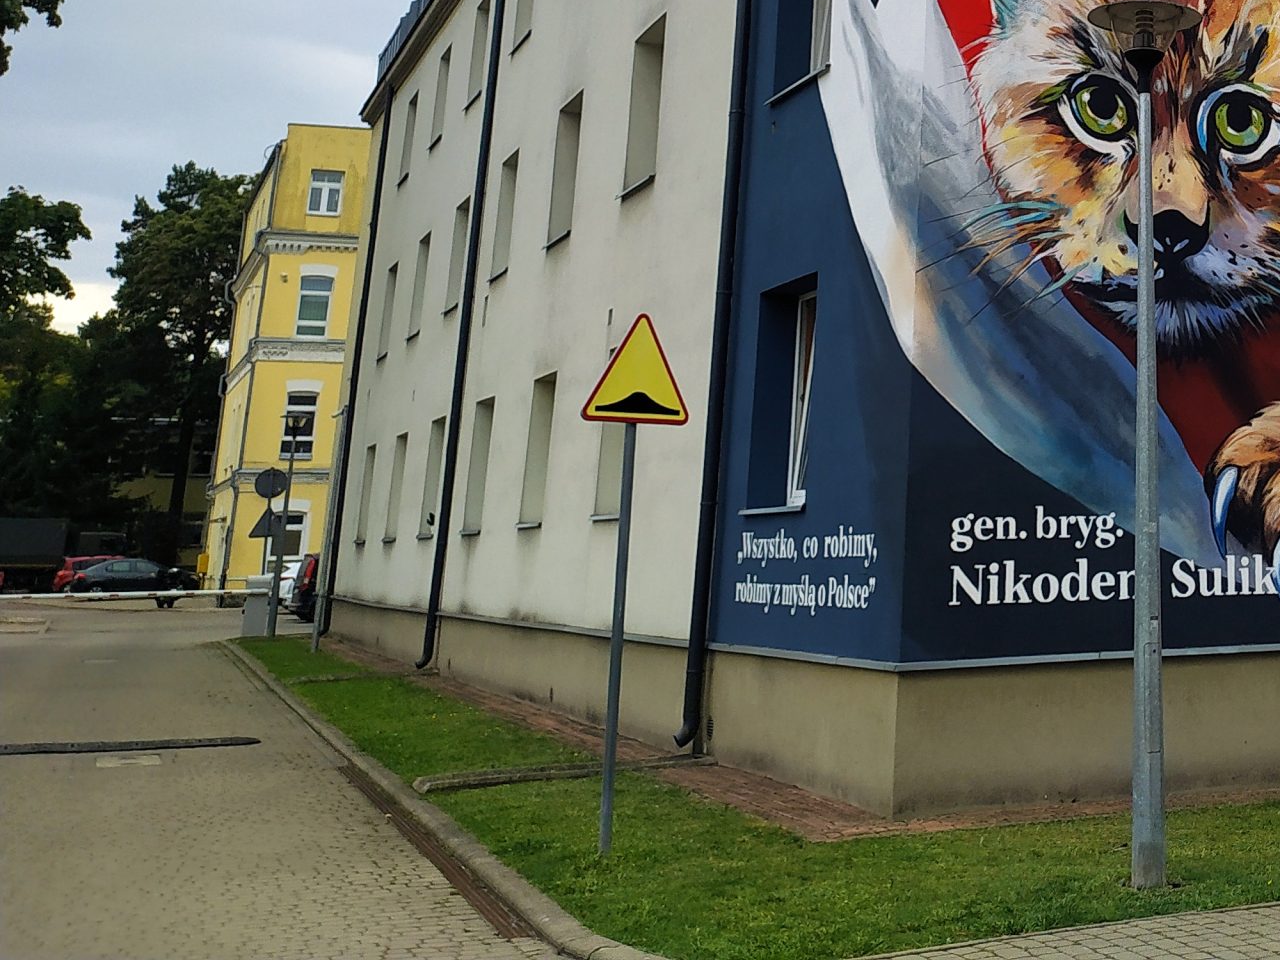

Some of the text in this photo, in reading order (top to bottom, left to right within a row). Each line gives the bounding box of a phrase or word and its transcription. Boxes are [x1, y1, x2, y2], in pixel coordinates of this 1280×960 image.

[802, 536, 818, 558] co
[824, 525, 877, 568] robimy,
[950, 505, 1124, 552] gen. bryg.
[735, 573, 773, 614] robimy
[773, 583, 781, 604] z
[781, 574, 816, 616] myślą
[818, 584, 826, 607] o
[1171, 553, 1279, 598] Sulik
